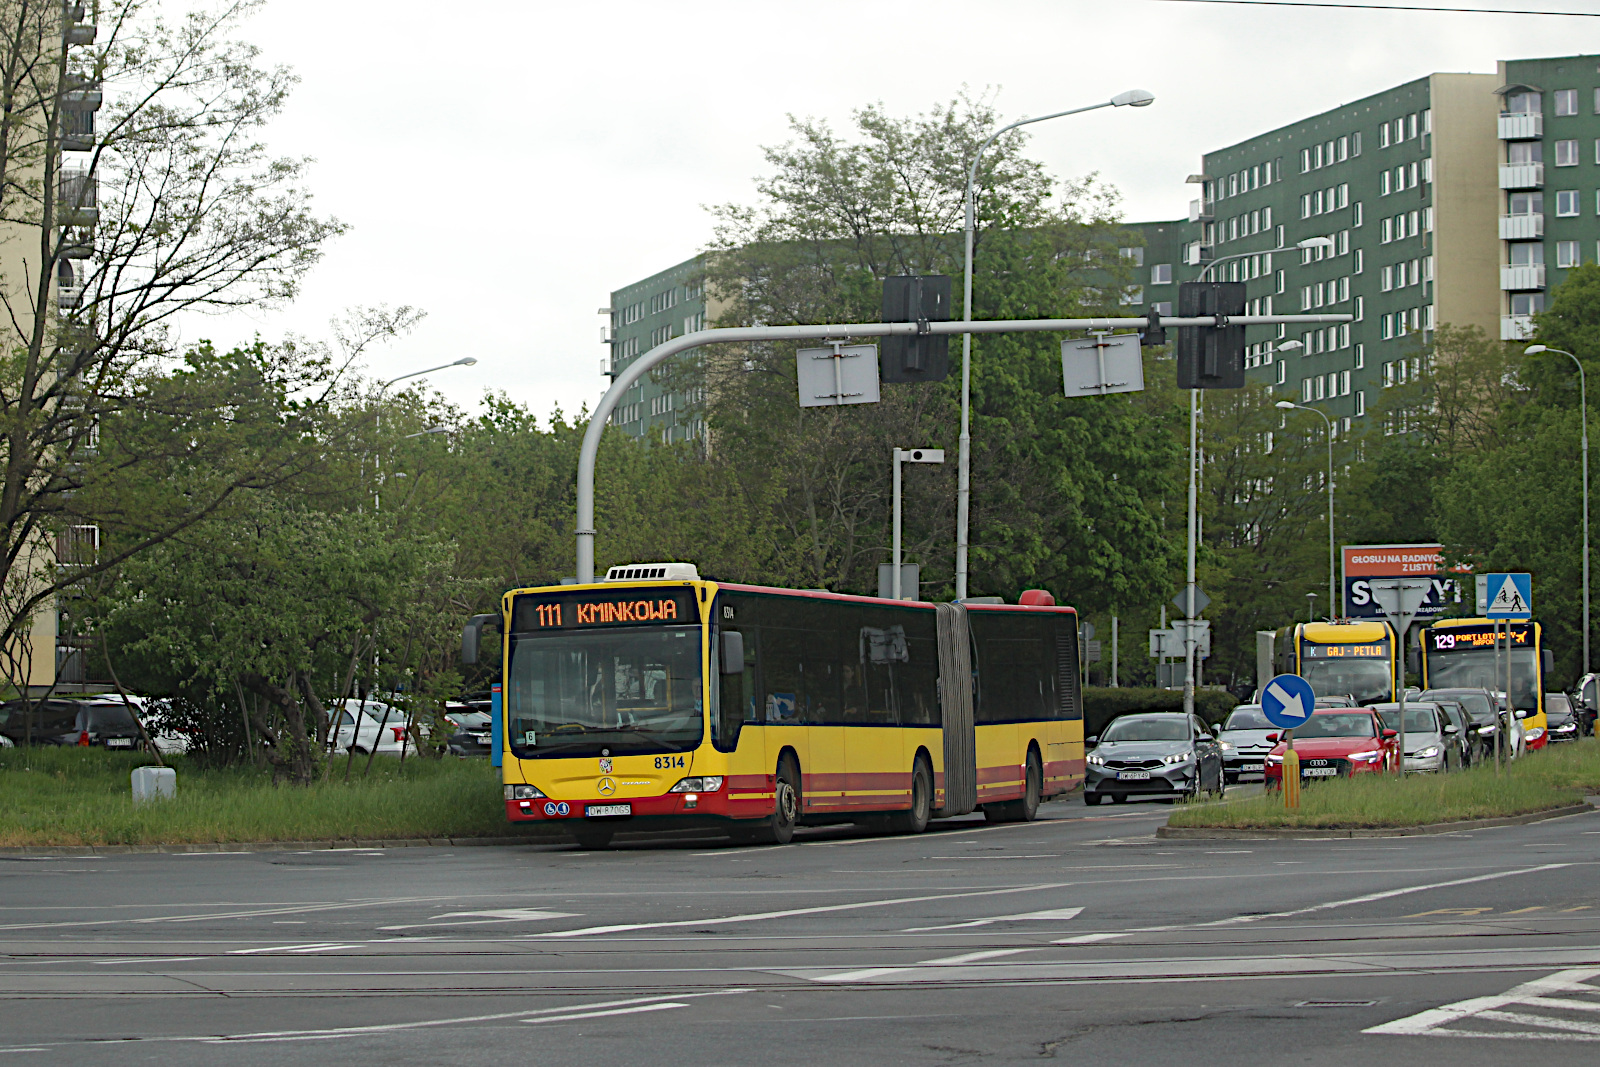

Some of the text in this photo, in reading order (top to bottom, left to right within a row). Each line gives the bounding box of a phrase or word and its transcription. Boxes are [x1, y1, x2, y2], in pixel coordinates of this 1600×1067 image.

[1351, 556, 1386, 564] GŁOSUJ
[1387, 555, 1400, 563] NA
[1409, 563, 1432, 572] LISTY
[535, 599, 677, 626] 111 KMINKOWA
[1434, 634, 1455, 649] 129
[1455, 634, 1476, 642] PORT
[1310, 646, 1317, 657] K
[1327, 646, 1344, 656] GAJ
[1353, 646, 1382, 656] PETLA
[654, 756, 685, 769] 8314
